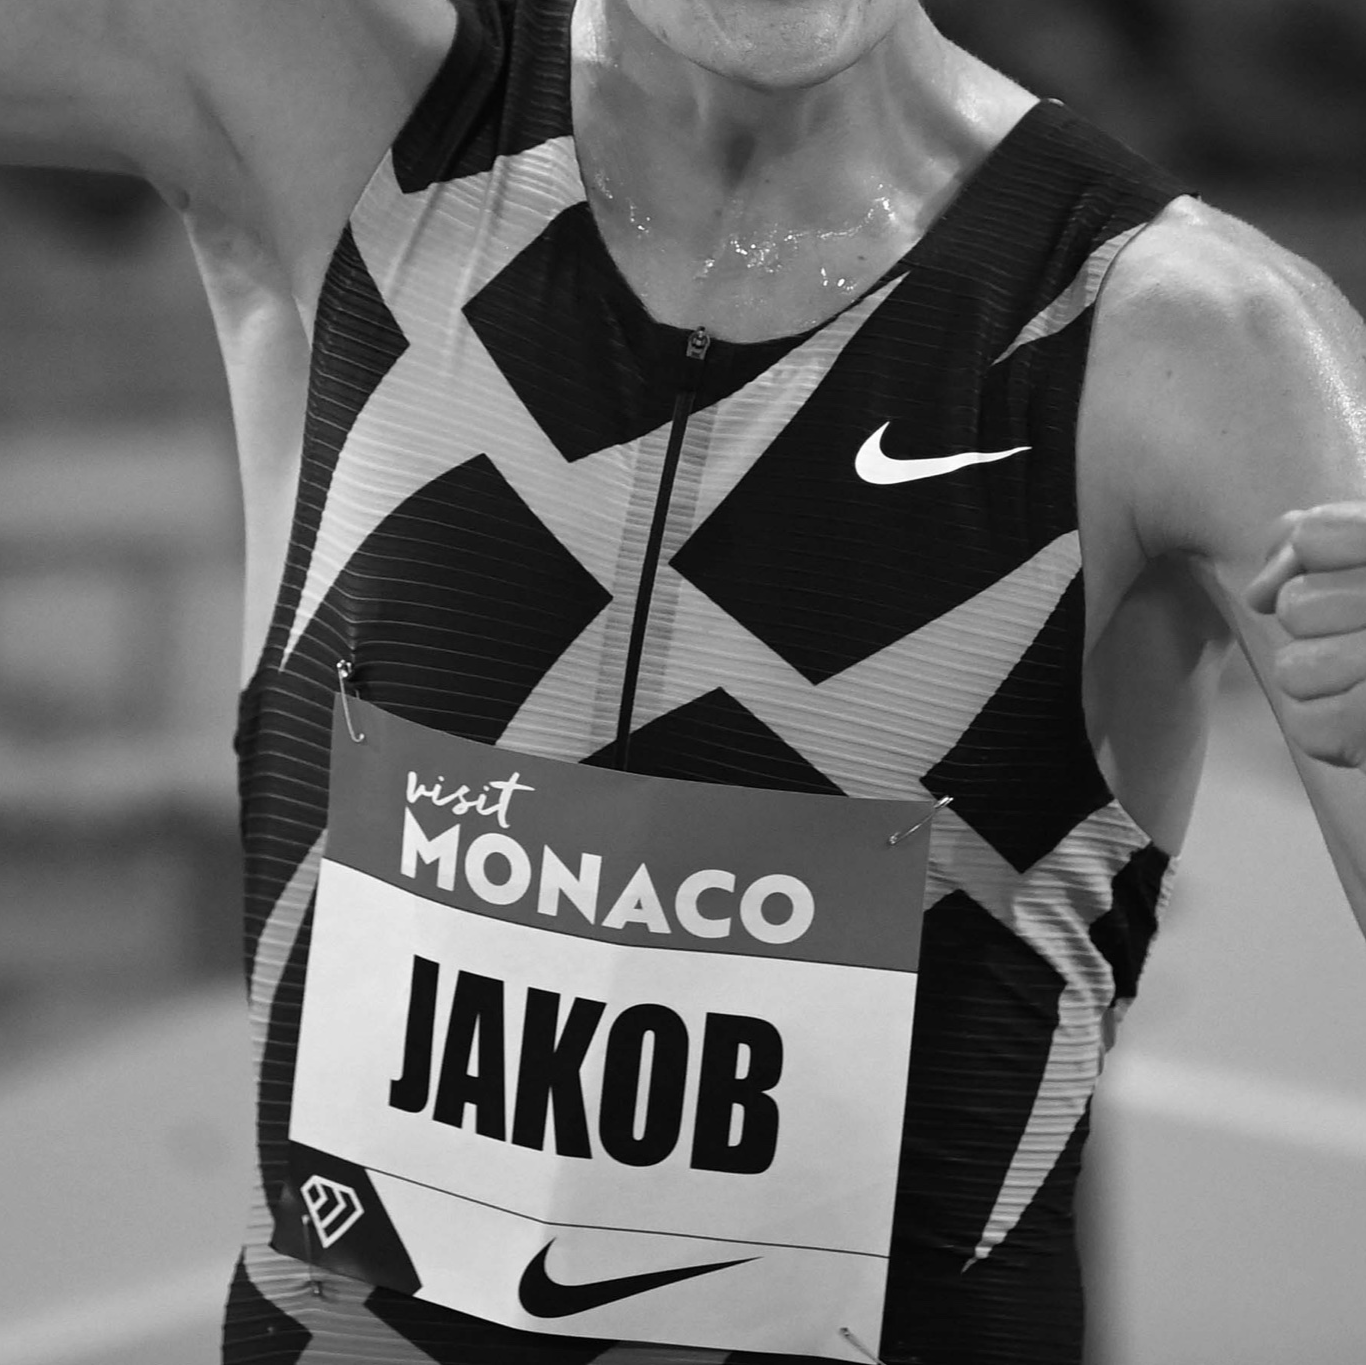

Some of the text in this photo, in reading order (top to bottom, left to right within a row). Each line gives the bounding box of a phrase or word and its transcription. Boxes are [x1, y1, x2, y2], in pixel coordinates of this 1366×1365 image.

[405, 770, 535, 829] visit
[400, 807, 815, 945] MONACO
[389, 954, 785, 1176] JAKOB
